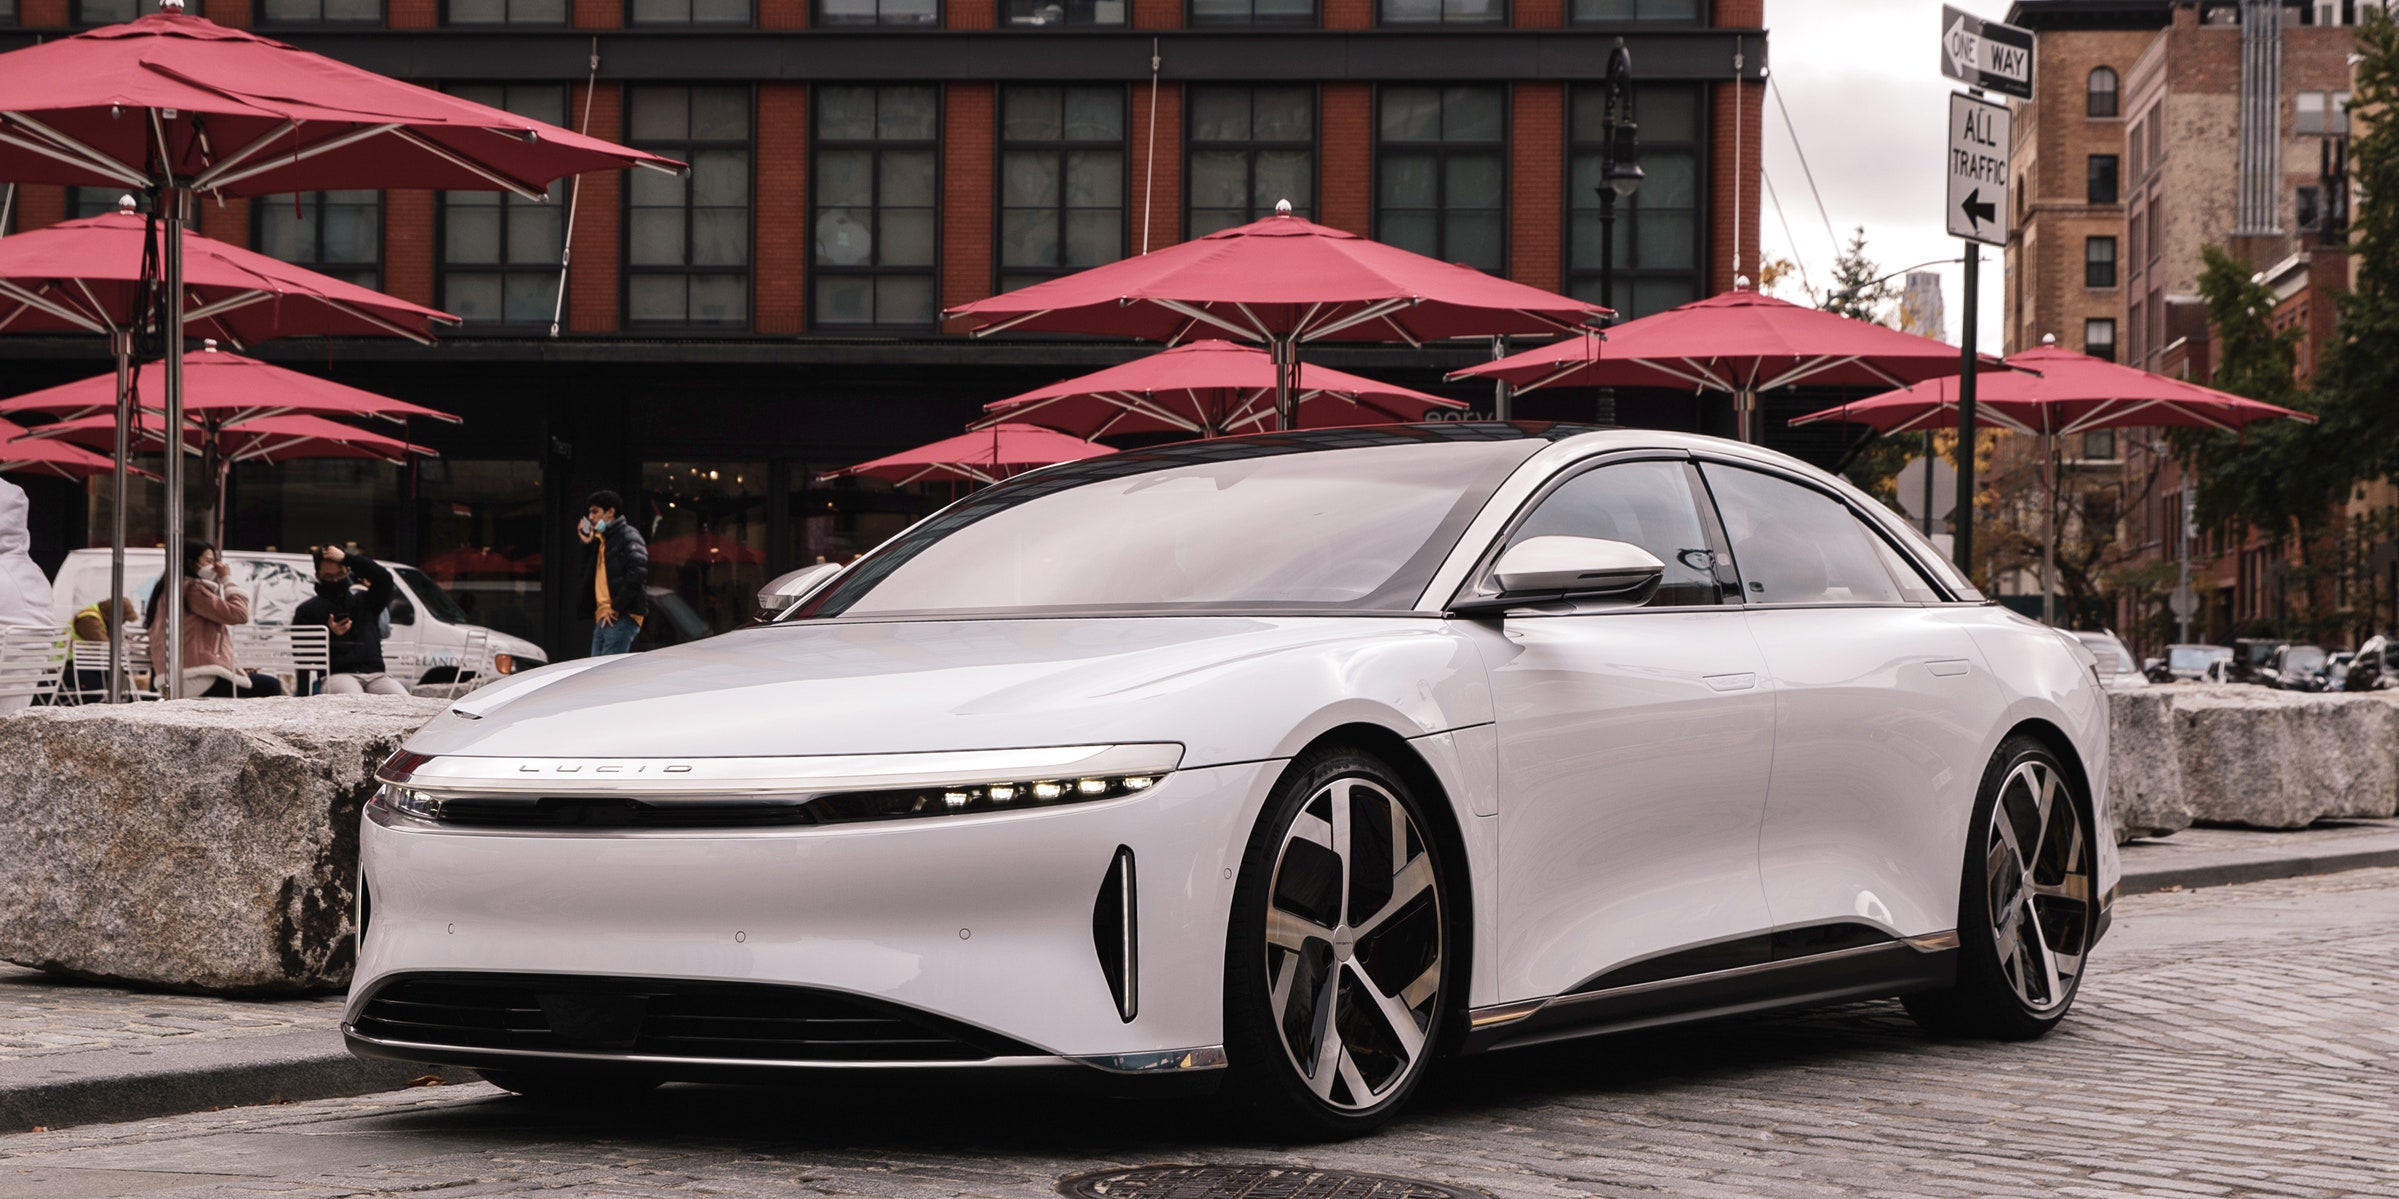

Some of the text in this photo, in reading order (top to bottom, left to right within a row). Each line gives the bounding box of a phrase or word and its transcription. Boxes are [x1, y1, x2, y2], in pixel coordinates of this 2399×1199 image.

[1952, 31, 2024, 77] ONE WAY
[1964, 108, 1996, 147] ALL
[1953, 149, 2006, 186] TRAFFIC
[519, 765, 693, 773] LUCID
